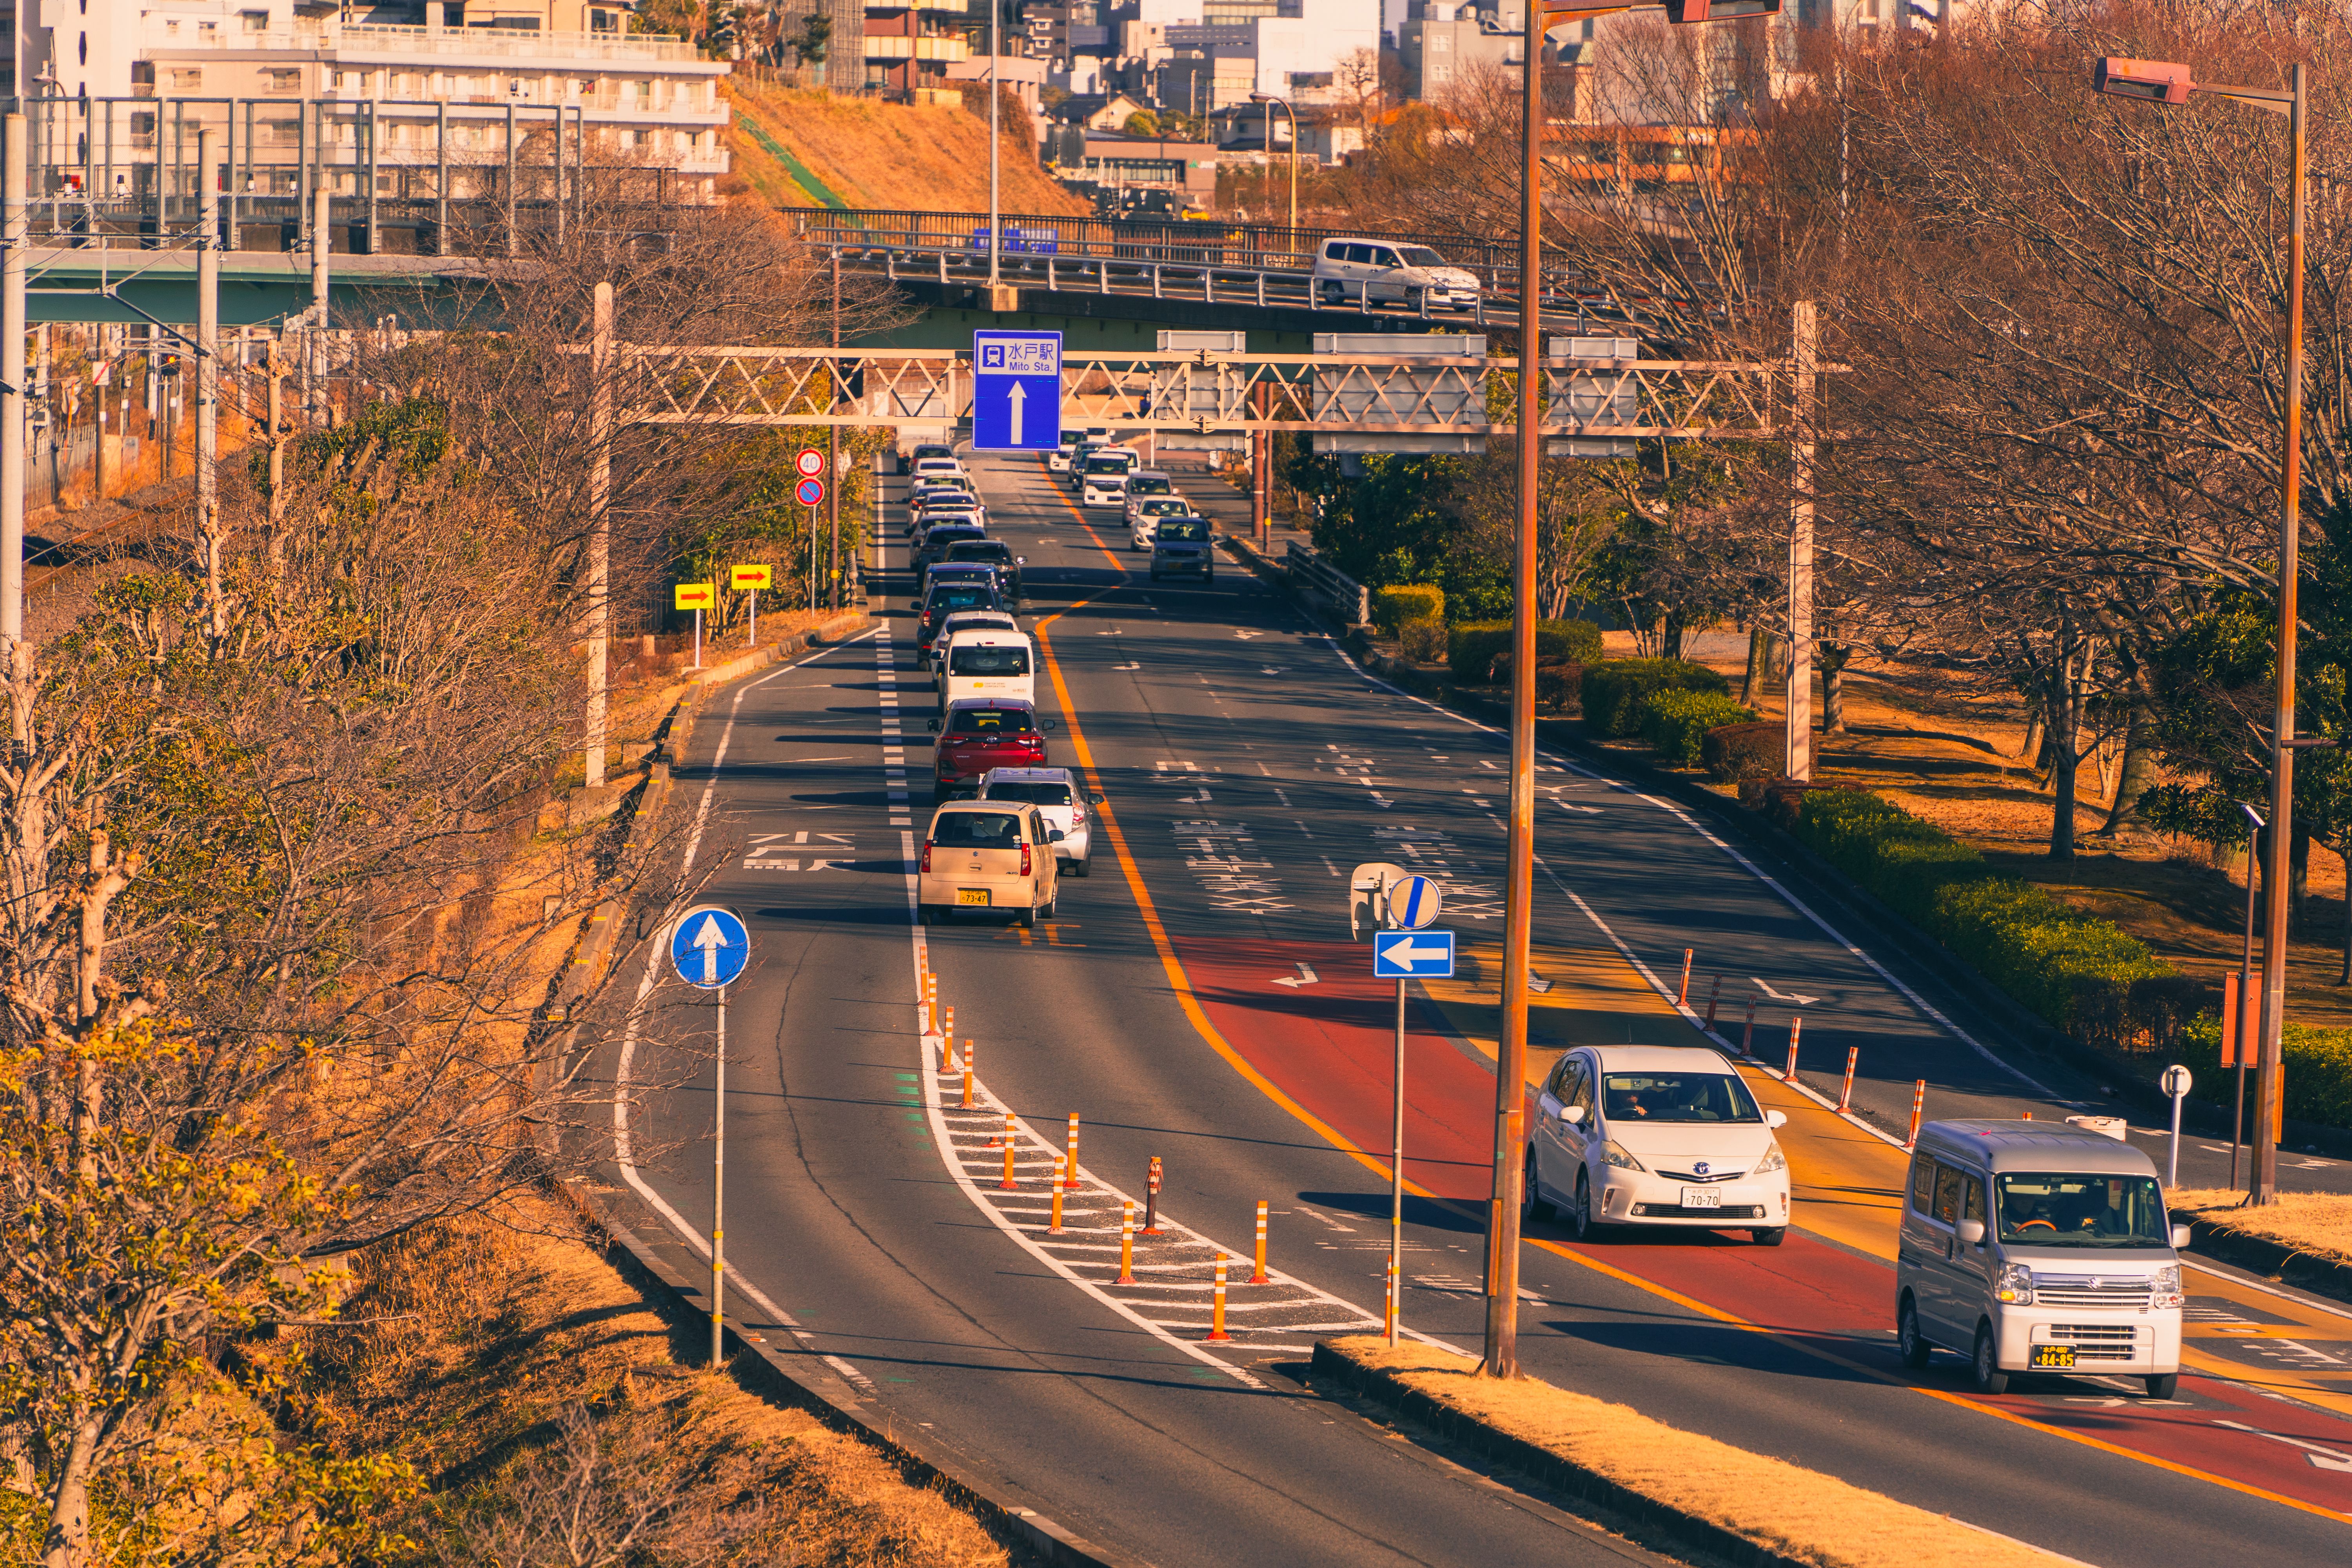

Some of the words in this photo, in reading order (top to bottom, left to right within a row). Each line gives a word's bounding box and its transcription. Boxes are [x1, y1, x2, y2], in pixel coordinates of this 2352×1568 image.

[1008, 343, 1053, 360] 水戸駅
[1009, 362, 1029, 371] Mito
[1034, 362, 1052, 372] Sta.
[803, 457, 817, 469] 40
[743, 831, 855, 871] 水戸駅
[1691, 1196, 1718, 1206] 70-70
[2041, 1354, 2074, 1366] 84-85
